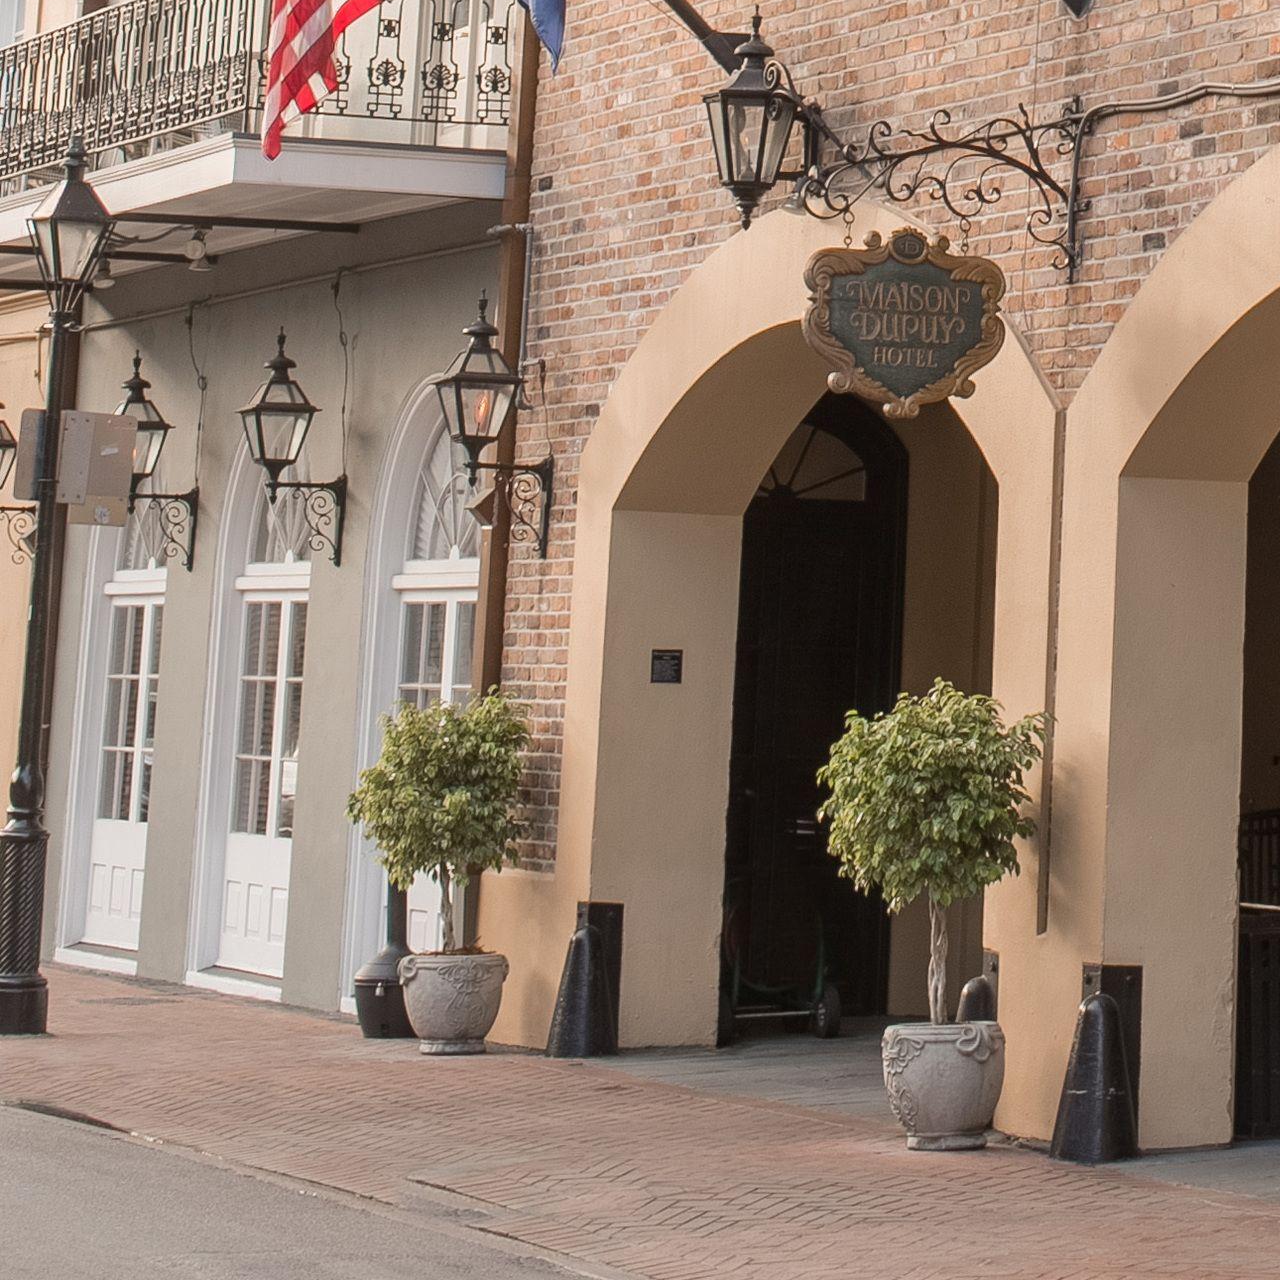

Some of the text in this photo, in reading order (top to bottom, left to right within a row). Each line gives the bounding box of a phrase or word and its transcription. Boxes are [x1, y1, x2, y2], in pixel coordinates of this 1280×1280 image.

[847, 282, 970, 314] MAISON
[850, 313, 965, 344] DUPUY
[873, 347, 938, 368] HOTEL
